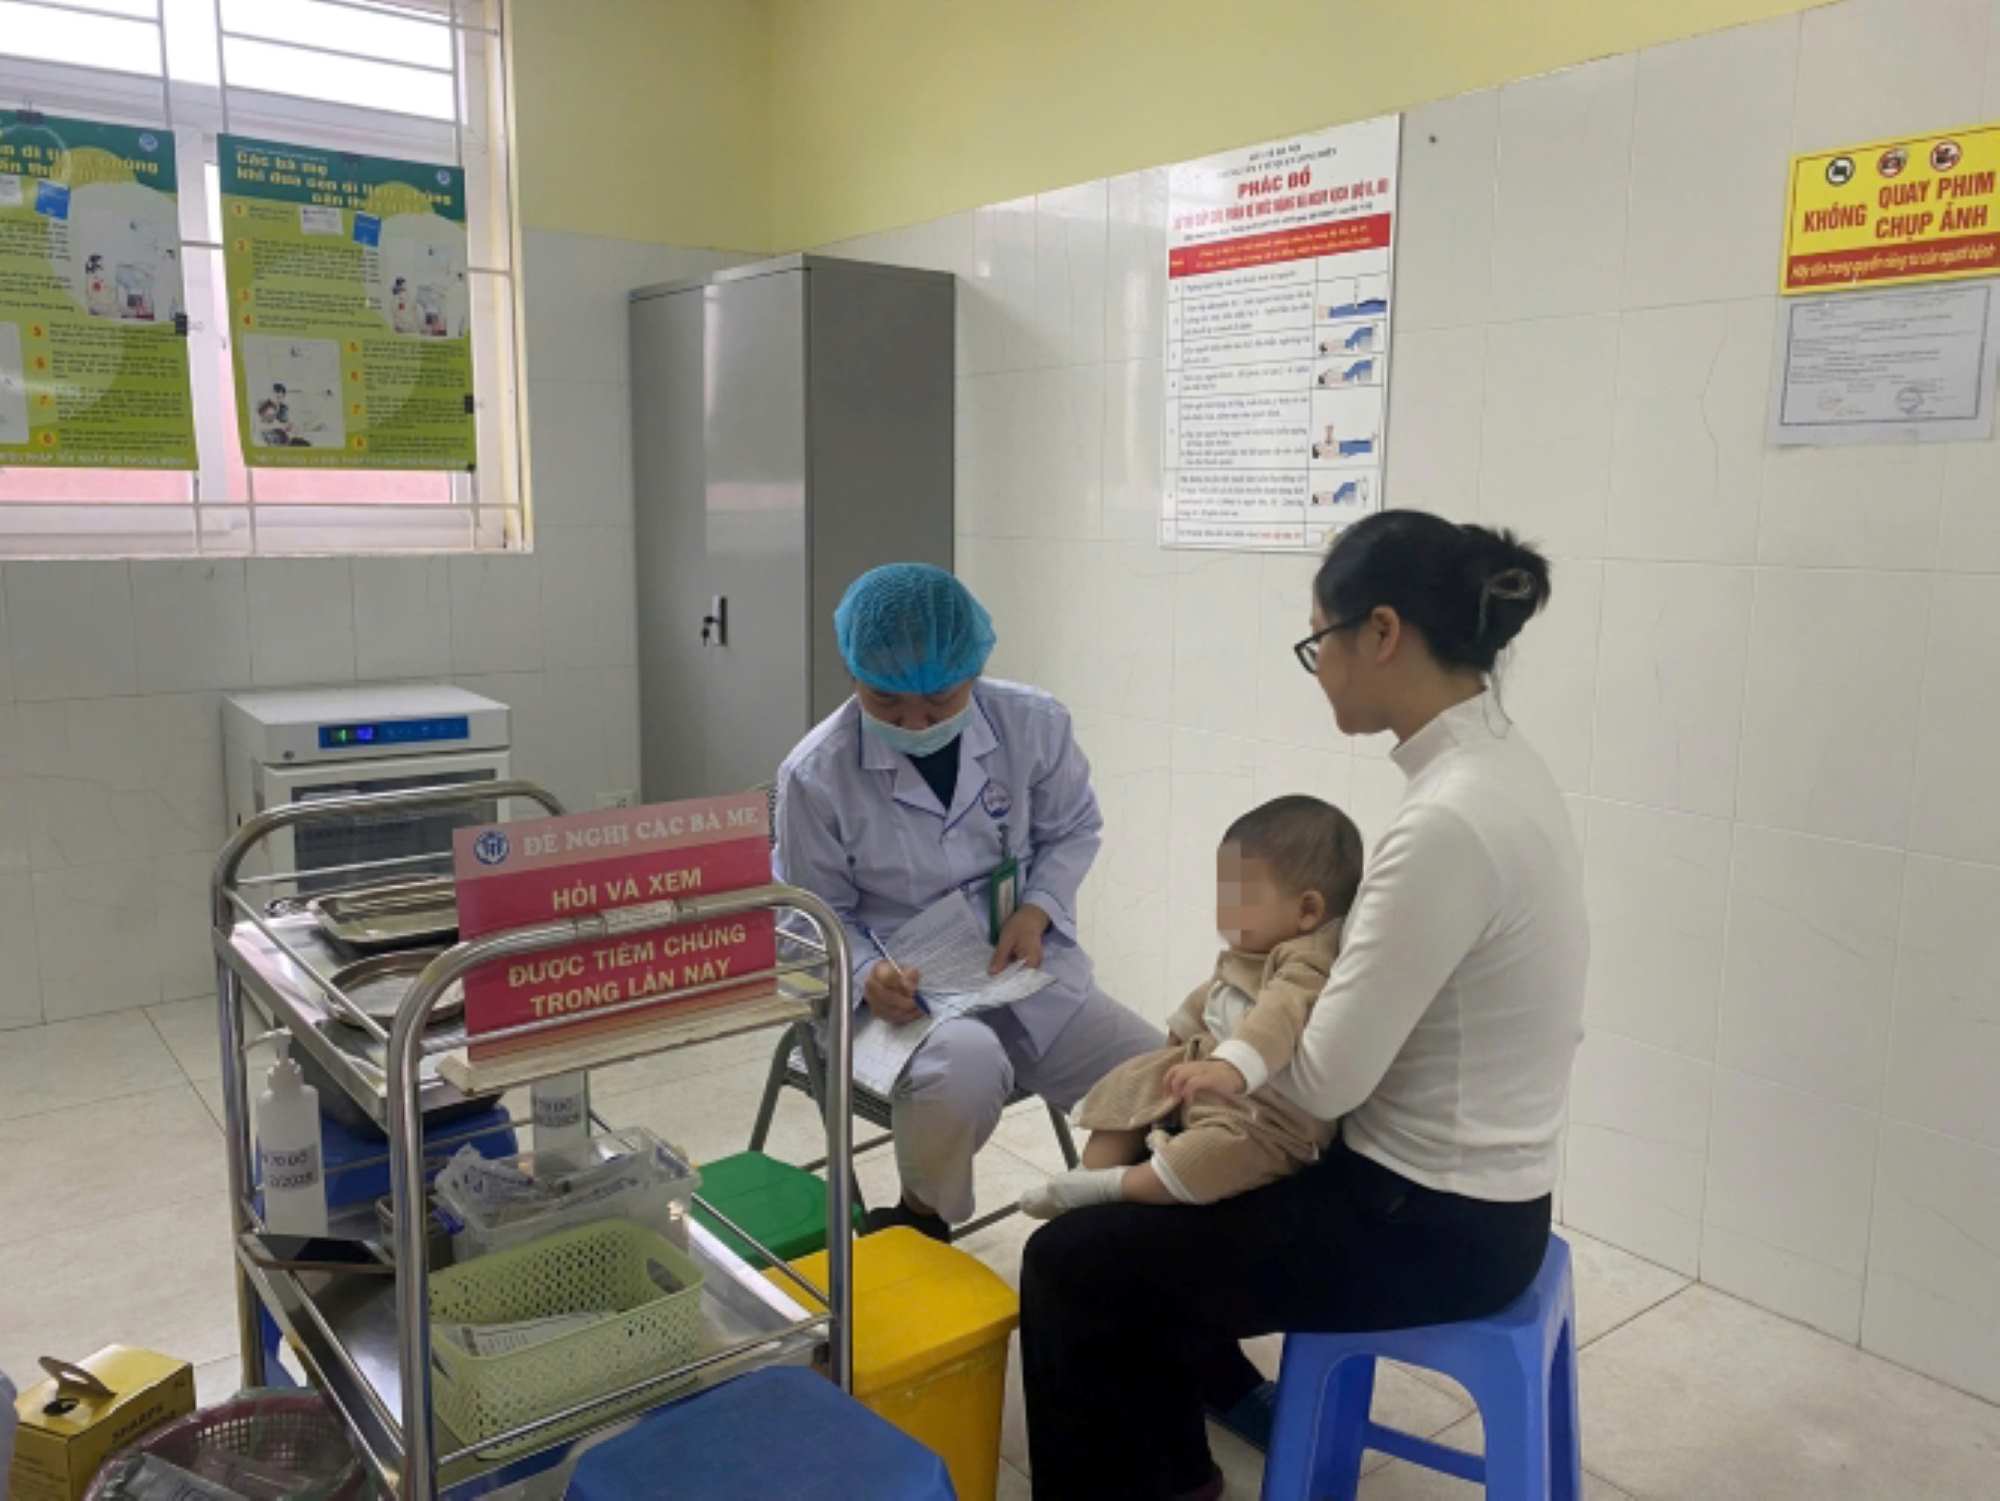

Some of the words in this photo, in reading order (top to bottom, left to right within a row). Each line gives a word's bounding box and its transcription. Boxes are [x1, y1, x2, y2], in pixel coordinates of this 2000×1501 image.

[1238, 174, 1283, 198] PHÁC
[1878, 181, 1930, 209] QUAY
[1936, 170, 1997, 199] PHIM
[1803, 201, 1867, 233] KHÔNG
[1875, 211, 1933, 242] CHỤP
[1938, 201, 1989, 232] ẢNH
[552, 879, 597, 911] HỎI
[606, 873, 639, 901] VÀ
[649, 867, 702, 894] XEM
[508, 954, 585, 988] ĐƯỢC
[593, 940, 654, 971] TIÊM
[664, 922, 747, 958] CHỦNG
[530, 978, 620, 1017] TRONG
[628, 962, 675, 998] LẦN
[684, 955, 731, 986] NÀY
